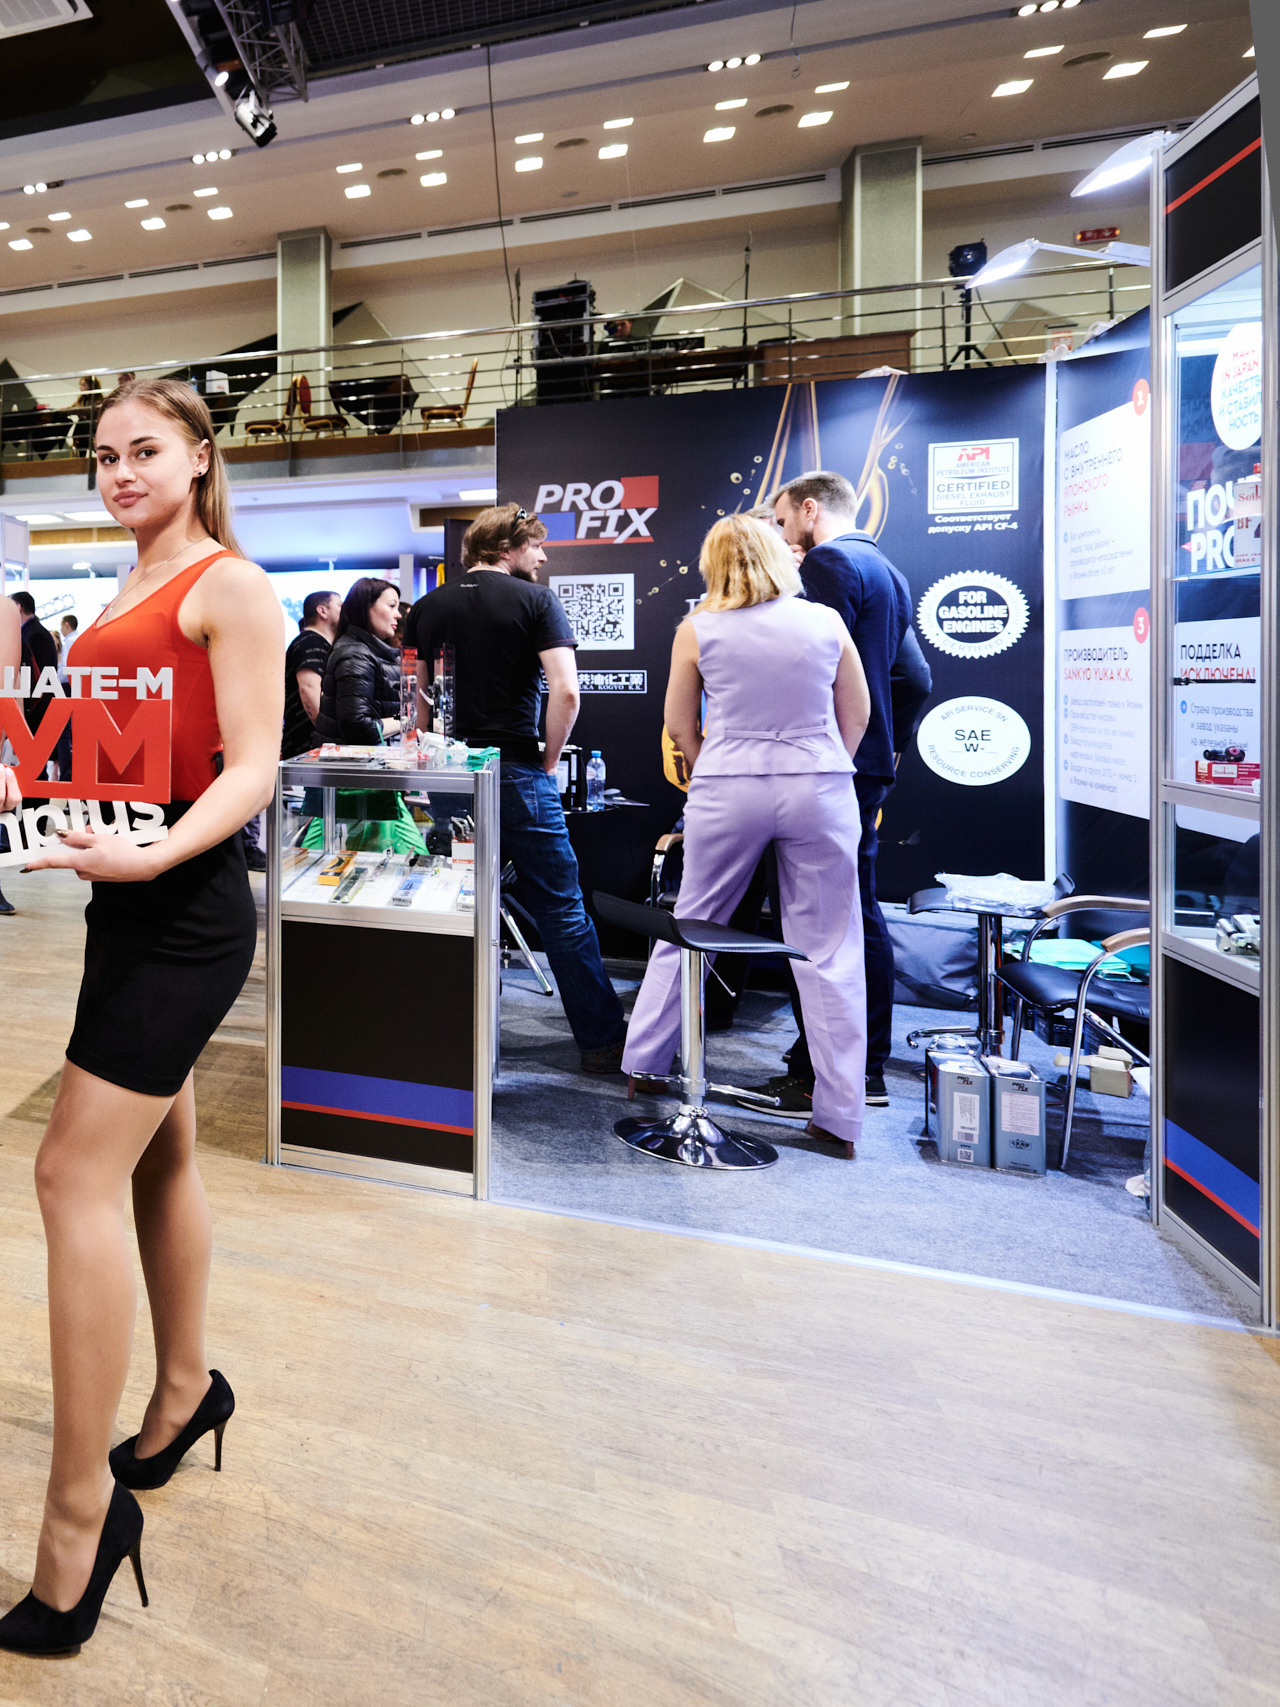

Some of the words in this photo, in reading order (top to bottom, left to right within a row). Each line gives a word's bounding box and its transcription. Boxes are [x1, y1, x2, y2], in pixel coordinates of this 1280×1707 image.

[1233, 357, 1258, 378] JAPAN
[1222, 374, 1261, 400] КАЧЕСТВ
[1227, 392, 1262, 415] СТАБИЛ
[1229, 411, 1259, 432] НОСТЬ
[958, 446, 990, 461] API
[1064, 440, 1089, 462] МАСЛО
[1071, 448, 1123, 478] ВНУТРЕННЕГО
[937, 480, 1010, 492] CERTIFIED
[1064, 473, 1109, 498] ЯПОНСКОГО
[534, 480, 625, 513] PRO
[970, 491, 1009, 499] EXHAUST
[1064, 500, 1088, 518] РЫНКА
[576, 507, 659, 544] FIX
[935, 514, 1012, 523] Соответствует
[928, 525, 972, 534] допуску
[994, 522, 1018, 530] CF-4
[958, 591, 987, 604] FOR
[938, 605, 1008, 619] GASOLINE
[942, 620, 1004, 633] ENGINES
[942, 639, 1003, 652] CERTIFIED
[1180, 643, 1241, 662] ПОДДЕЛКА
[1064, 647, 1128, 663] ПРОИЗВОДИТЕЛЬ
[1064, 667, 1091, 680] SANKYO
[1094, 667, 1114, 680] YUKA
[1117, 668, 1133, 681] K.K.
[1180, 667, 1255, 680] ИСКЛЮЧЕНА!
[941, 710, 954, 721] API
[954, 704, 995, 715] SERVICE
[995, 712, 1008, 722] SN
[1190, 703, 1210, 715] Страна
[1211, 706, 1253, 717] производства
[954, 729, 992, 741] SAE
[1196, 722, 1212, 732] завод
[1214, 723, 1238, 734] указаны
[1199, 738, 1227, 748] железной
[928, 744, 966, 777] RESOURCE
[970, 746, 1020, 778] CONSERVING
